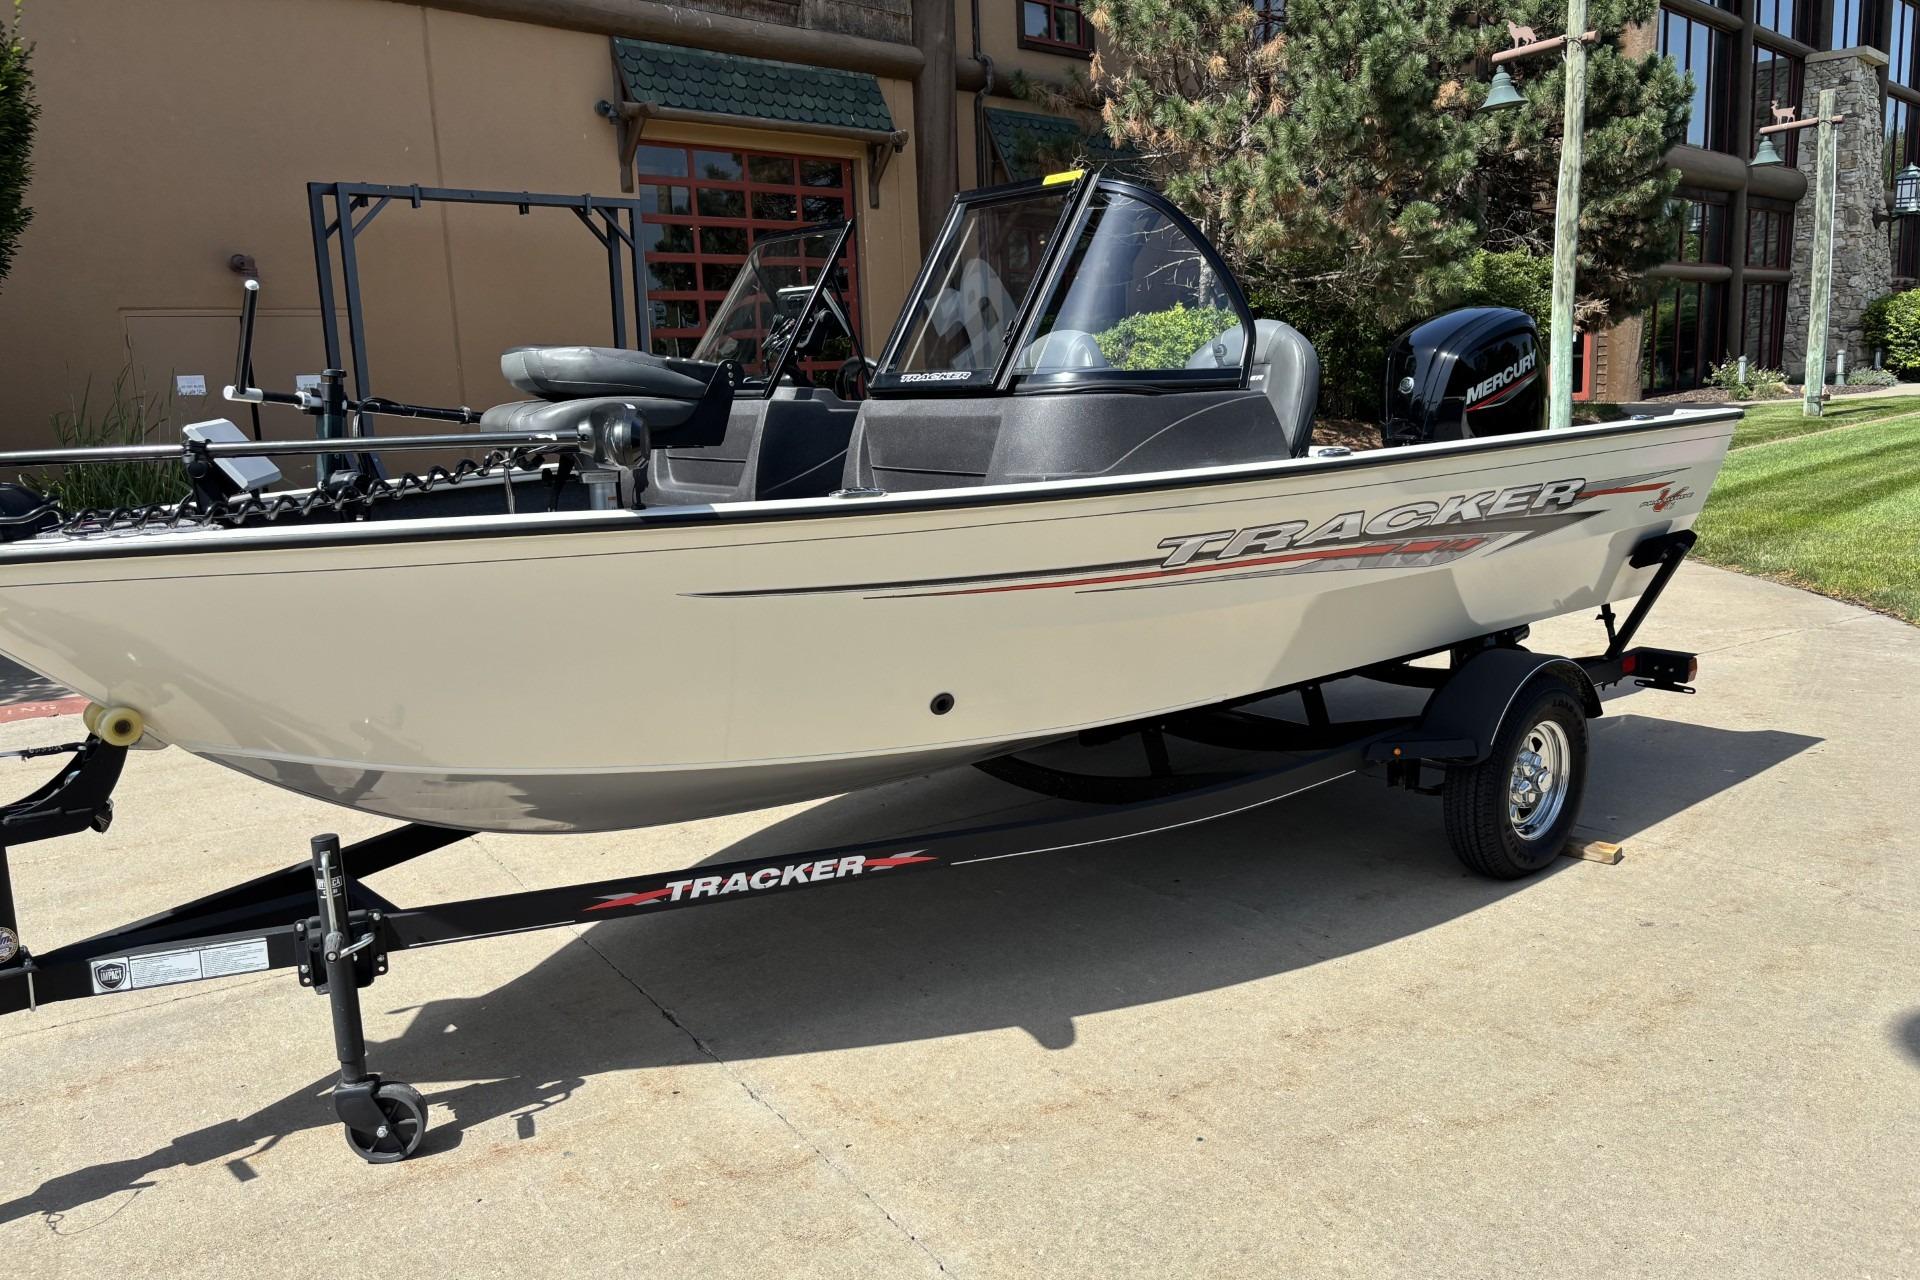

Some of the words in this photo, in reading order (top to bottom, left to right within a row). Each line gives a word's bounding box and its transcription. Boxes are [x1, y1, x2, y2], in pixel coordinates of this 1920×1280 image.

[900, 371, 972, 383] TRACKER
[1466, 348, 1537, 405] MERCURY
[1157, 477, 1587, 568] TRACKER
[665, 855, 866, 902] TRACKER
[100, 969, 123, 982] IMPACT
